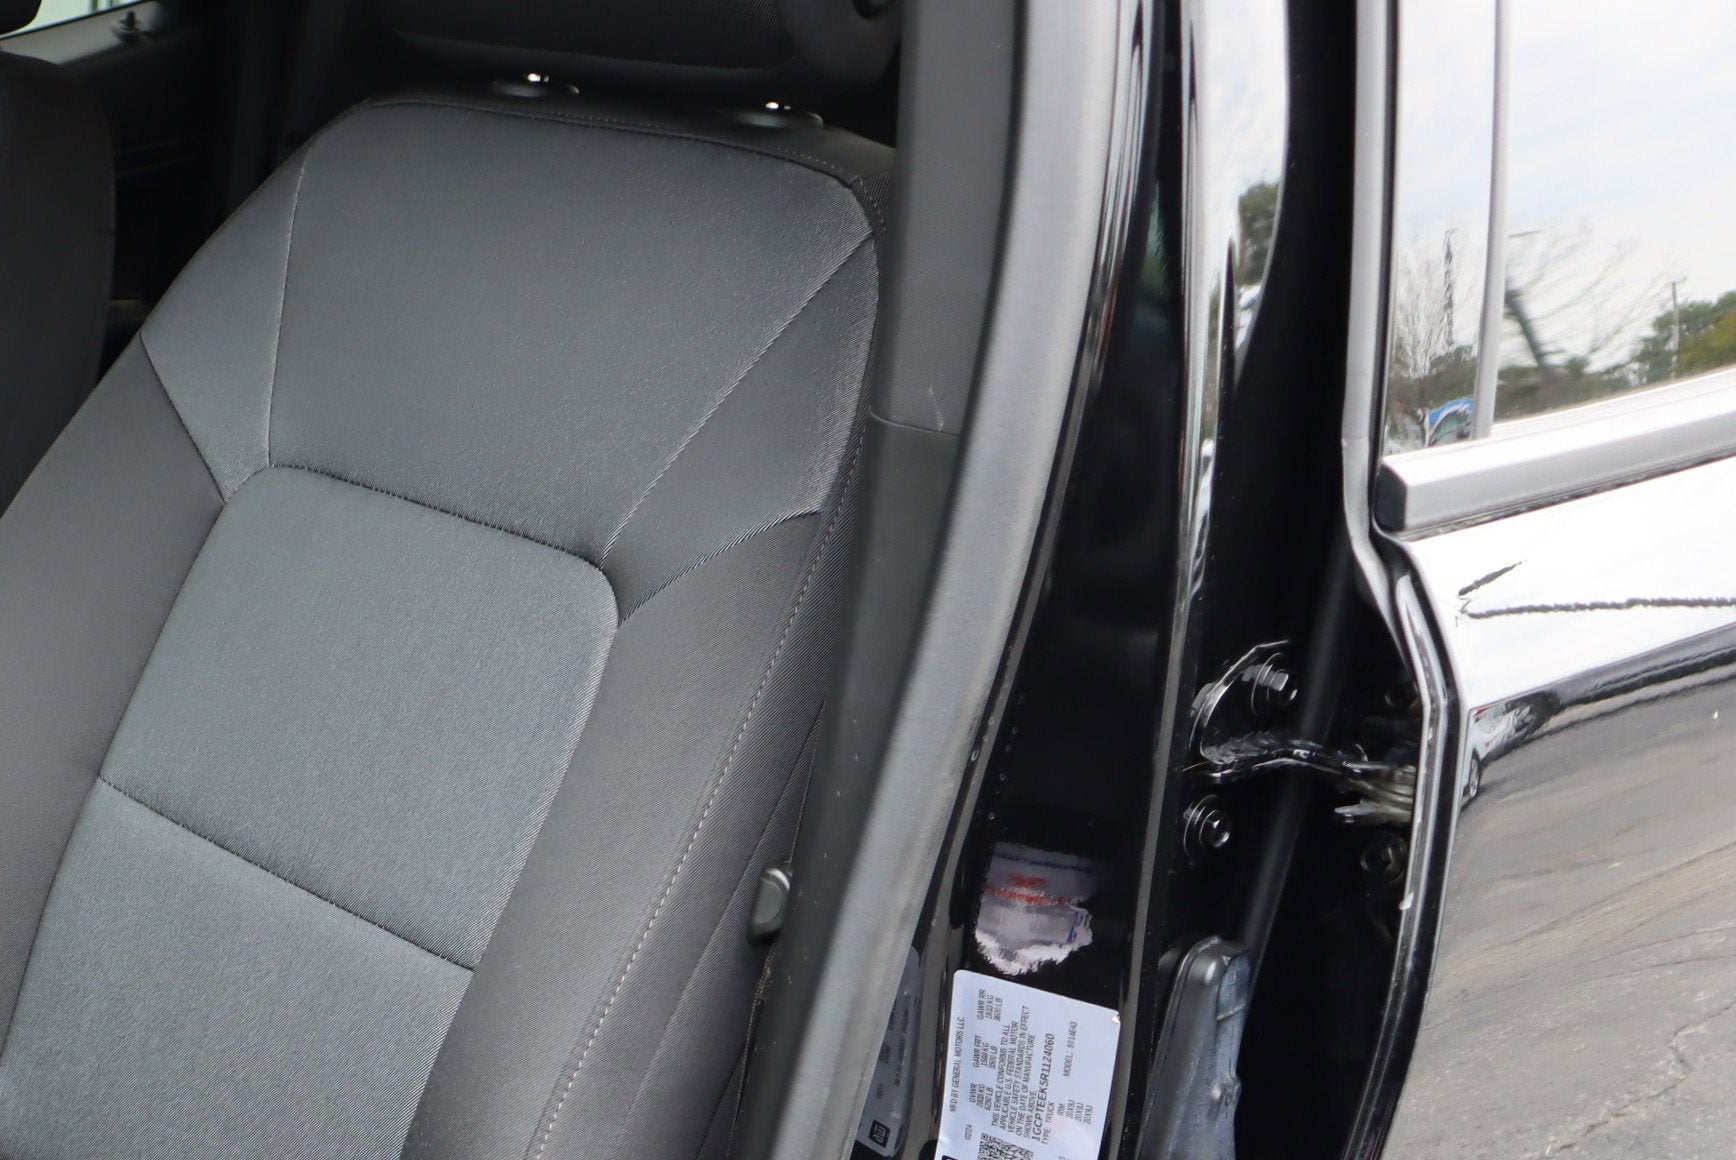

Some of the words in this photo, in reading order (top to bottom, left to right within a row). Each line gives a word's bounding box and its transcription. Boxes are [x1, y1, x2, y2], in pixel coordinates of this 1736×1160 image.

[956, 1016, 965, 1029] LLC
[1019, 1005, 1030, 1030] EFFECT
[953, 1029, 964, 1057] MOTORS
[1001, 1036, 1008, 1046] TO
[1009, 1020, 1019, 1045] MOTOR
[996, 1047, 1007, 1083] CONFORMS
[1005, 1046, 1016, 1076] FEDERAL
[1013, 1039, 1026, 1078] STANDARDS
[1021, 1033, 1036, 1082] MANUFACTURE
[951, 1057, 961, 1088] GENERAL
[993, 1084, 1003, 1111] VEHICLE
[1010, 1079, 1020, 1104] SAFETY
[1020, 1082, 1029, 1093] OF
[1030, 1032, 1055, 1142] 1GCPTEEK5R1124060
[999, 1090, 1011, 1130] APPLICABLE
[1018, 1093, 1027, 1111] DATE
[1027, 1090, 1036, 1113] ABOVE
[1045, 1101, 1054, 1123] TRUCK
[991, 1112, 999, 1127] THIS
[1007, 1105, 1017, 1133] VEHICLE
[1016, 1111, 1025, 1124] THE
[1023, 1113, 1033, 1139] SHOWN
[1015, 1125, 1023, 1136] ON
